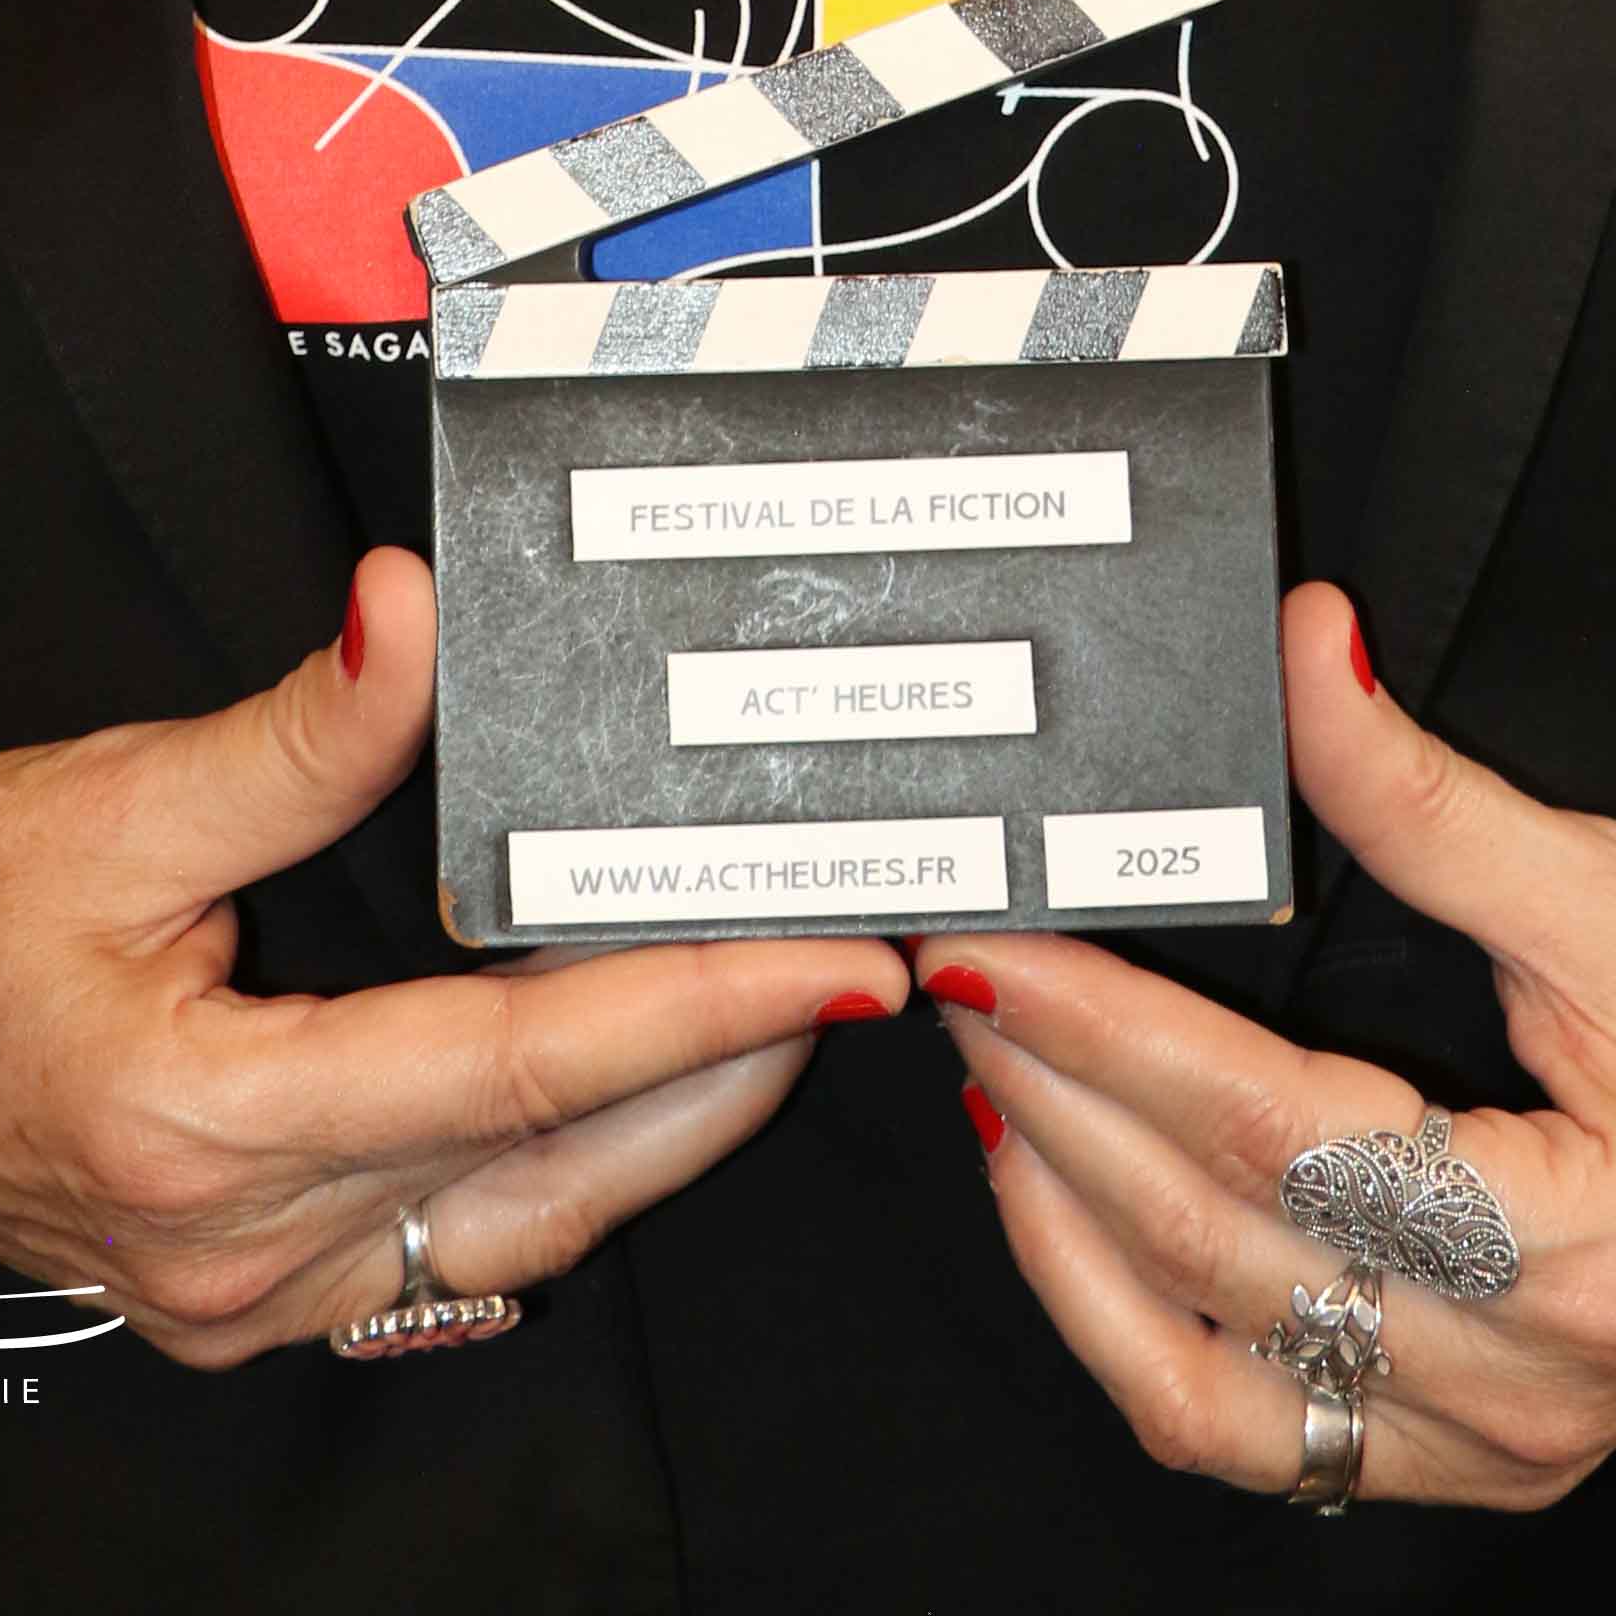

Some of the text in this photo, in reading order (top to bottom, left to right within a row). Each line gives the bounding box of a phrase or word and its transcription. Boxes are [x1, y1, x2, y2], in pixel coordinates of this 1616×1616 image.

[286, 329, 431, 364] E SAGA
[629, 489, 1067, 533] FESTIVAL DE LA FICTION
[739, 680, 974, 717] ACT' HEURES
[568, 854, 958, 897] WWW.ACTHEURES.FR
[1115, 844, 1202, 879] 2025
